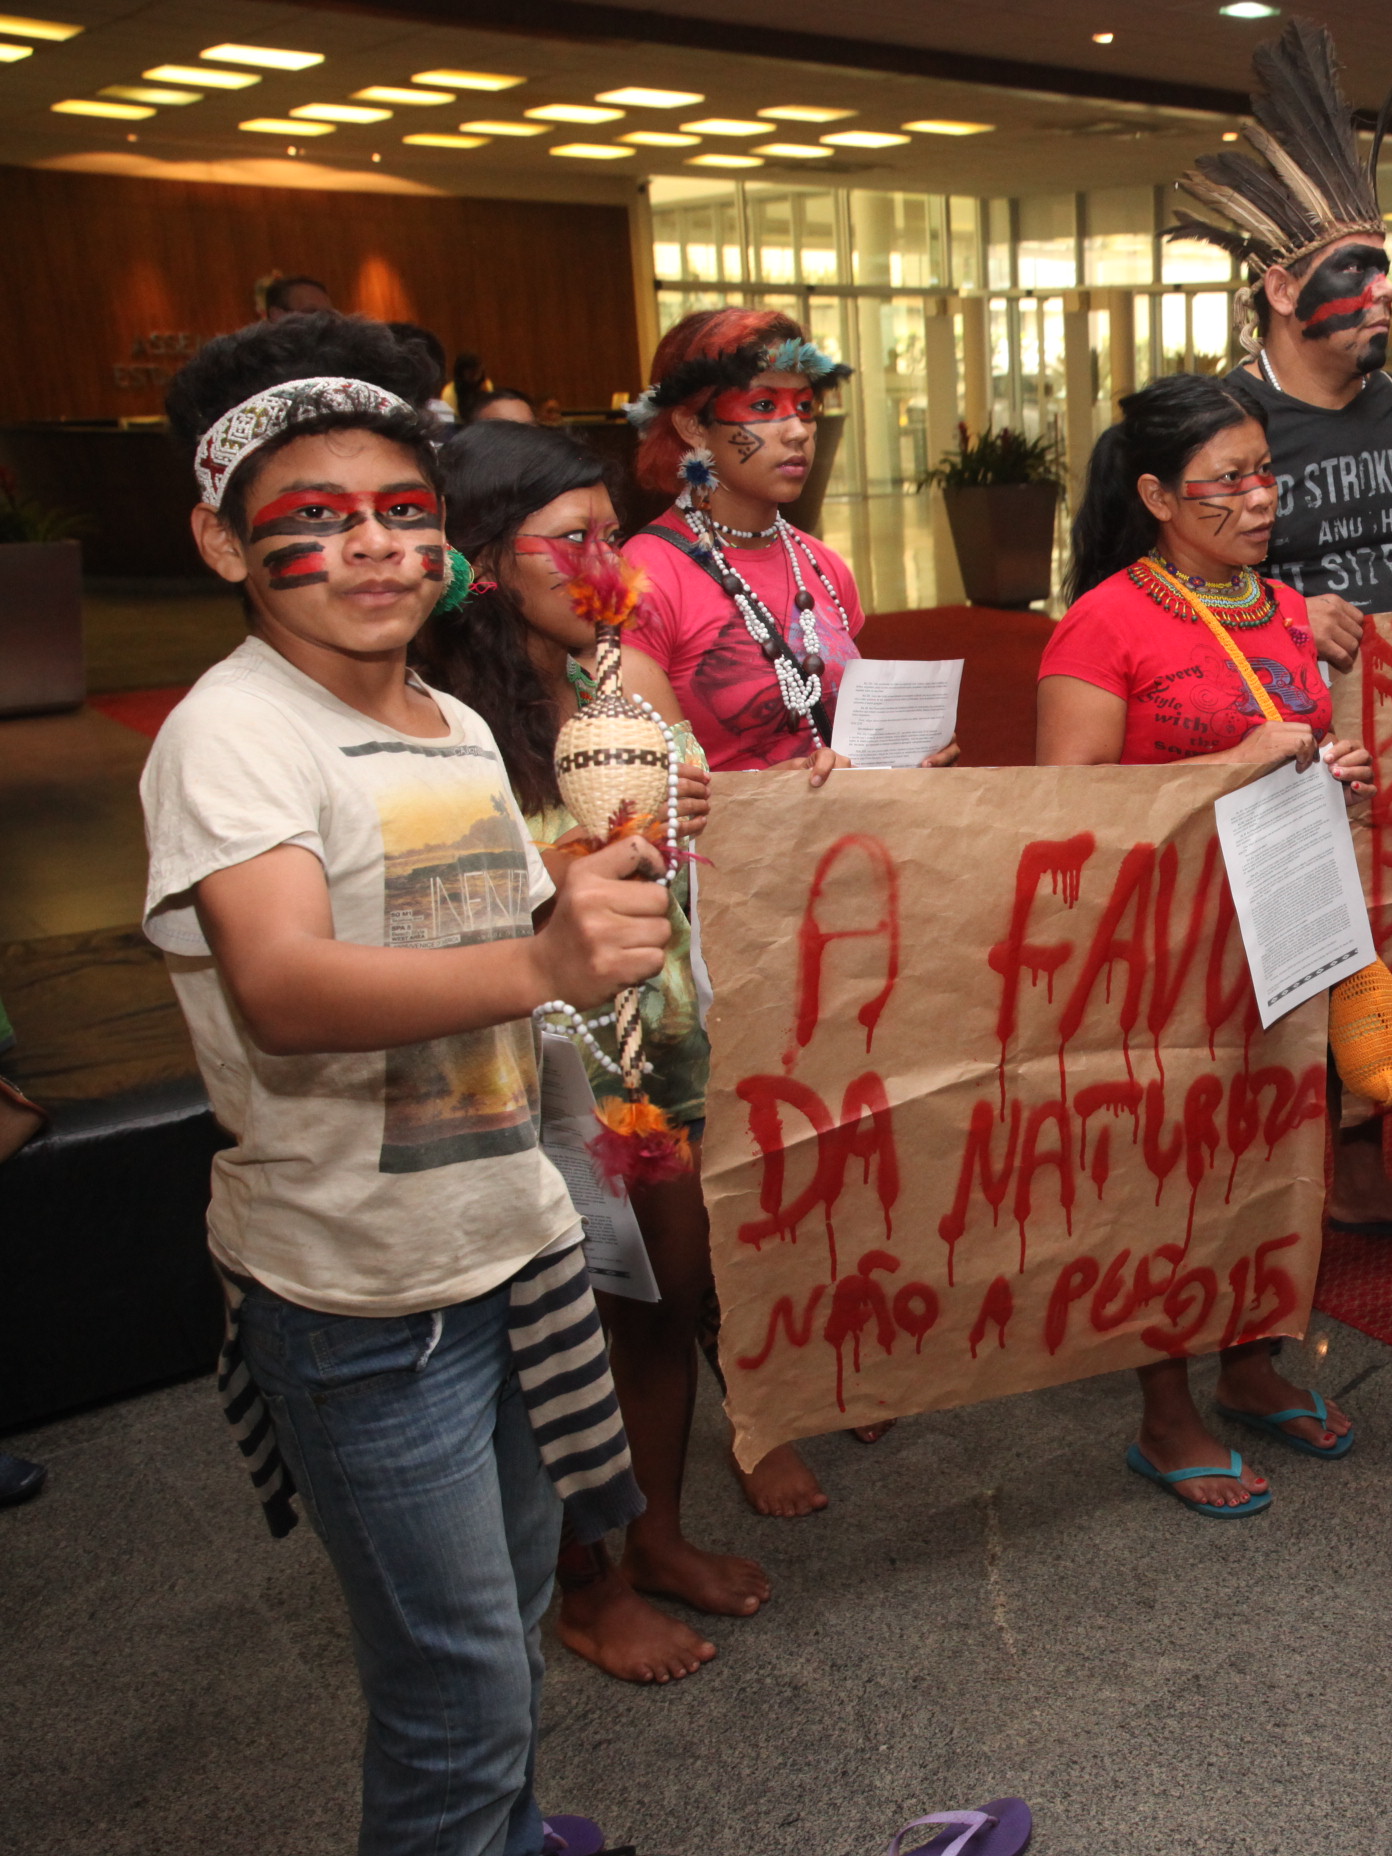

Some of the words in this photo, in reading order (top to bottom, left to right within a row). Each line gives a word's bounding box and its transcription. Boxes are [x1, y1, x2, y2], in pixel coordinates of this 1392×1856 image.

[1318, 516, 1363, 546] AND
[1155, 712, 1209, 734] with
[794, 832, 900, 1050] A
[735, 1070, 901, 1243] DA
[735, 1248, 943, 1372] NÃO
[968, 1274, 1015, 1352] A
